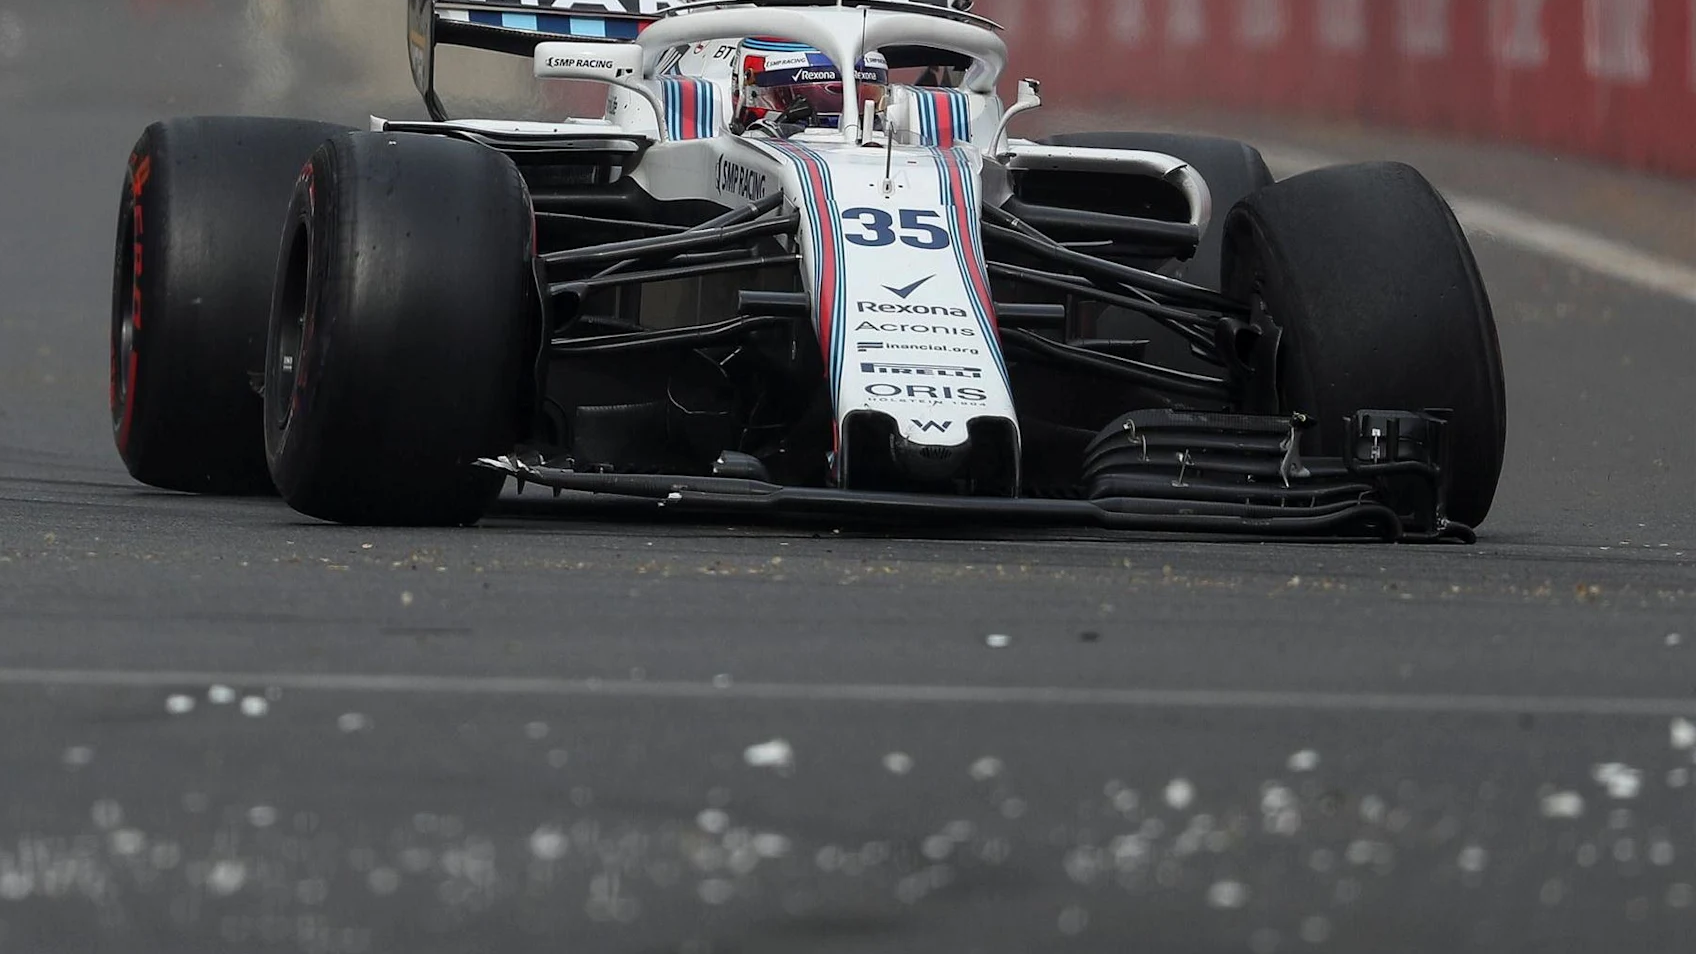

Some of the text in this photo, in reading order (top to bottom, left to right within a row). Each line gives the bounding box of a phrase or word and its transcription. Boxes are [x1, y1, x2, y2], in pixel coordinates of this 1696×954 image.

[554, 58, 613, 68] SMP RACING
[801, 71, 836, 80] Rexona
[841, 207, 950, 250] 35
[856, 301, 967, 317] Rexona
[855, 321, 975, 336] Acronis
[860, 362, 982, 378] PIRELLI
[864, 384, 987, 400] ORIS
[910, 418, 953, 433] W
